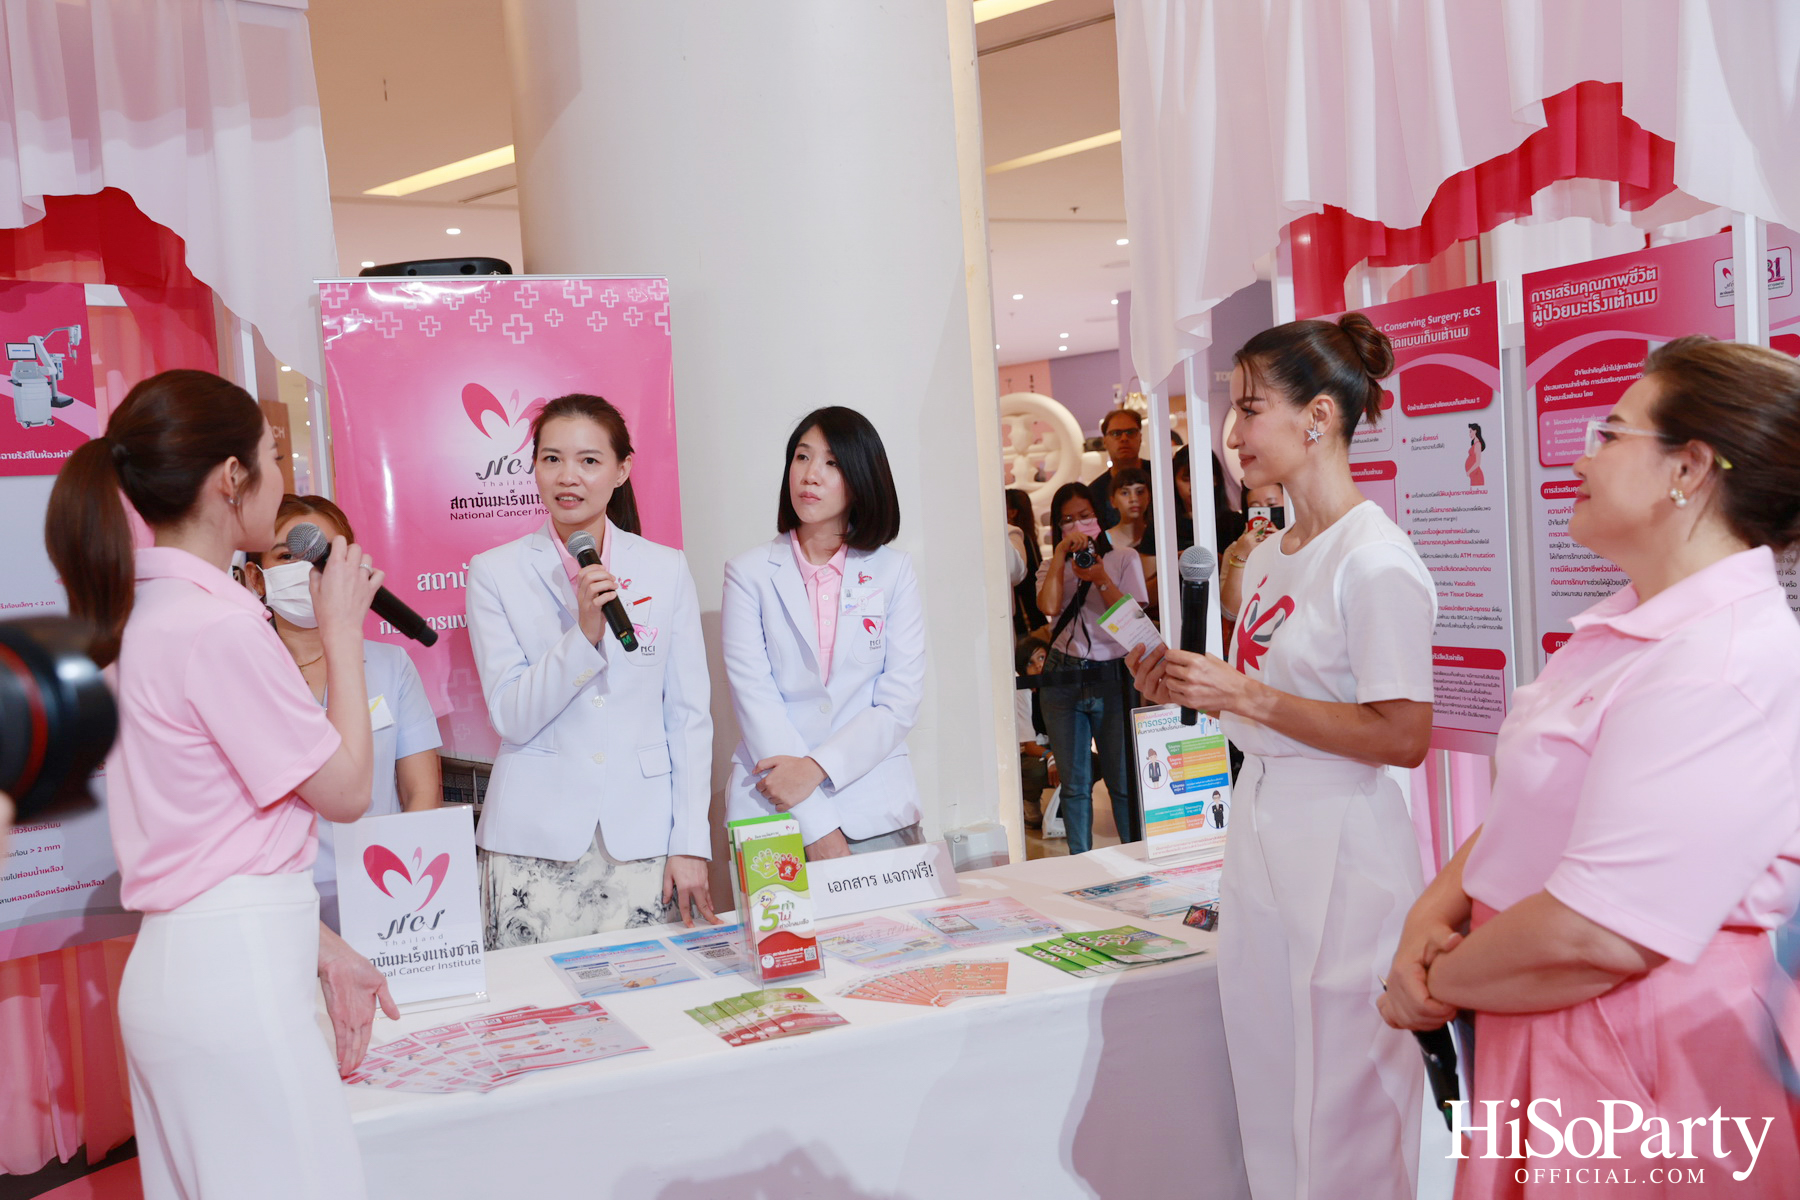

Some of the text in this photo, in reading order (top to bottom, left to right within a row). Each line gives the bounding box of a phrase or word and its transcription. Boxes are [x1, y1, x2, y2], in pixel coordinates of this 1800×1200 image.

[1531, 267, 1657, 304] การเสริมคุณภาพชีวิต
[1384, 317, 1427, 333] Conserving
[1427, 312, 1462, 325] Surgery:
[1463, 306, 1482, 318] BCS
[1532, 288, 1657, 328] ผู้ป่วยมะเร็งเต้านม
[272, 425, 285, 439] CH
[481, 479, 537, 488] Thailan
[450, 507, 550, 521] National Cancer Ins
[640, 645, 656, 653] NCI
[44, 844, 61, 852] mm
[827, 860, 935, 894] เอกสาร แจกฟรี!
[759, 904, 780, 931] 5
[384, 933, 444, 948] Thailand
[369, 940, 480, 969] าบันมะเร็งแห่งชาติ
[383, 956, 482, 979] nal Cancer Institute
